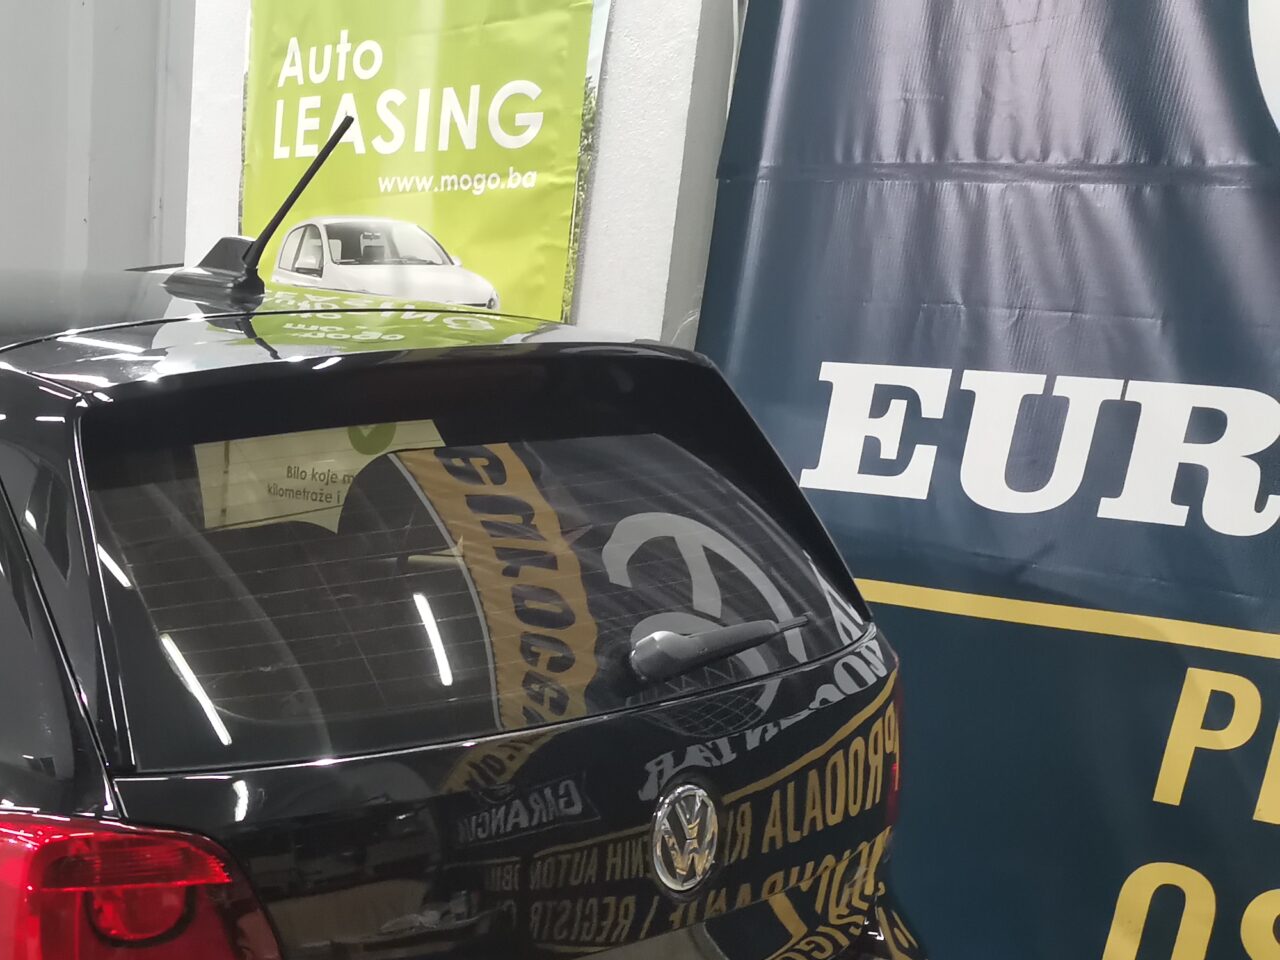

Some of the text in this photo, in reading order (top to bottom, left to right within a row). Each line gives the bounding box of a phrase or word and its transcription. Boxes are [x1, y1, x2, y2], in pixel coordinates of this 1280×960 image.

[277, 29, 383, 87] Auto
[273, 80, 544, 160] LEASING
[378, 167, 537, 195] www.mogo.ba
[286, 465, 308, 481] Bilo
[311, 468, 338, 486] koje
[1152, 667, 1280, 823] P
